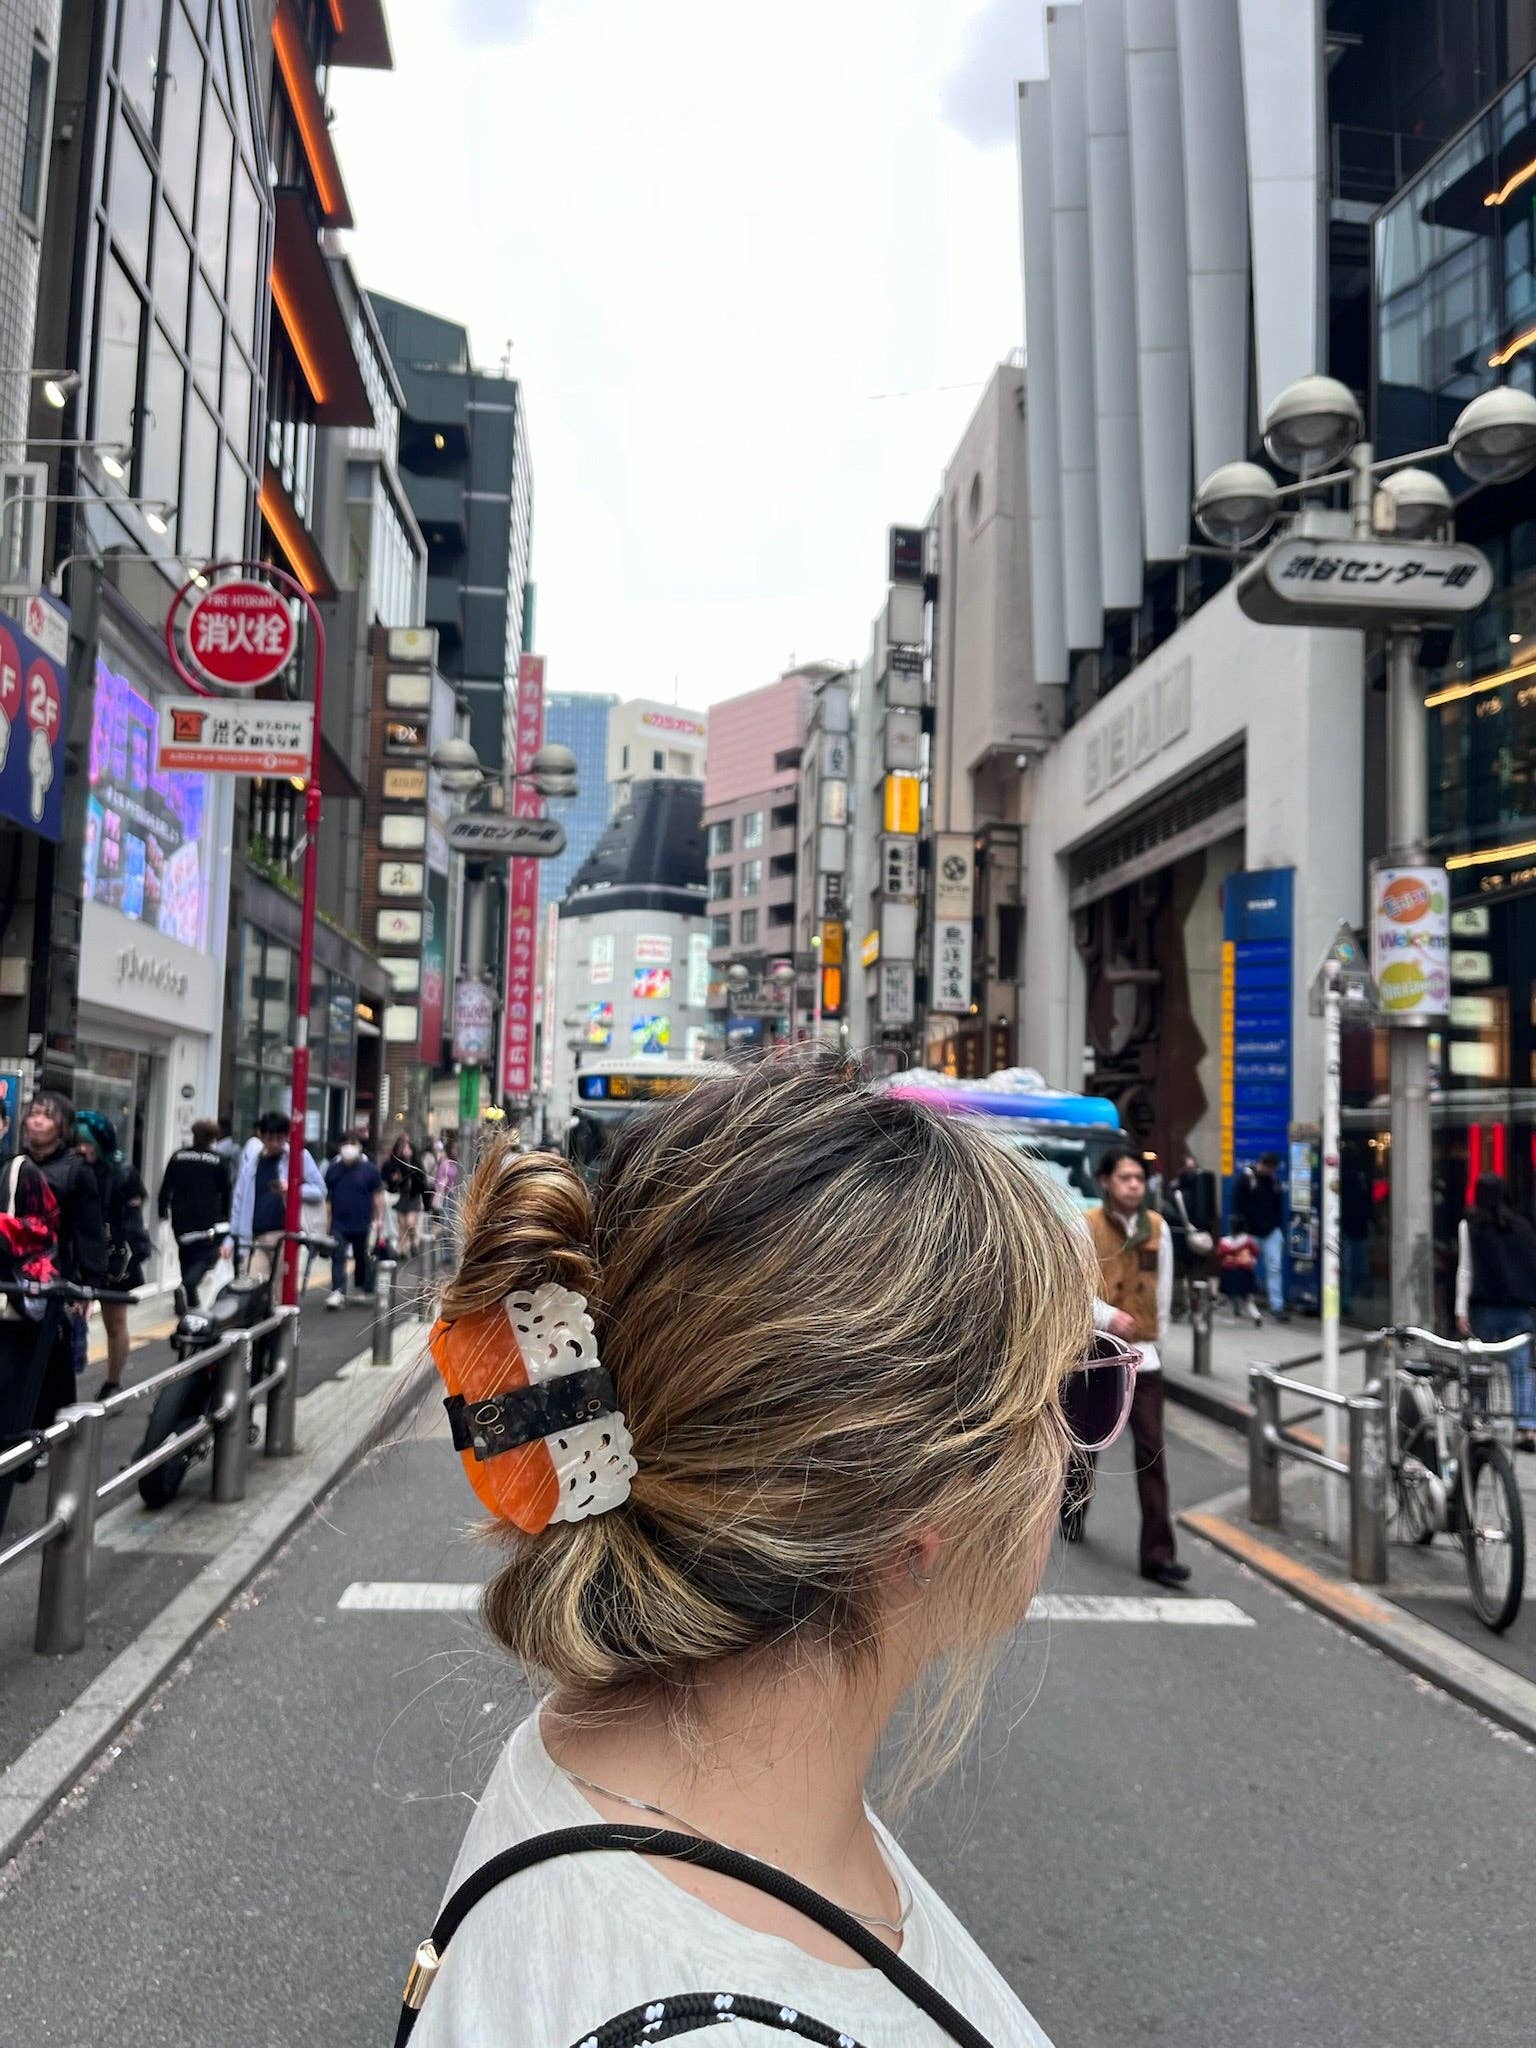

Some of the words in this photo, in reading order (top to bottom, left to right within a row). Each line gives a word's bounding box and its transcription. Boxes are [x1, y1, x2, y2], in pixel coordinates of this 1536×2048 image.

[197, 611, 287, 655] 消火栓
[31, 673, 58, 727] 2F
